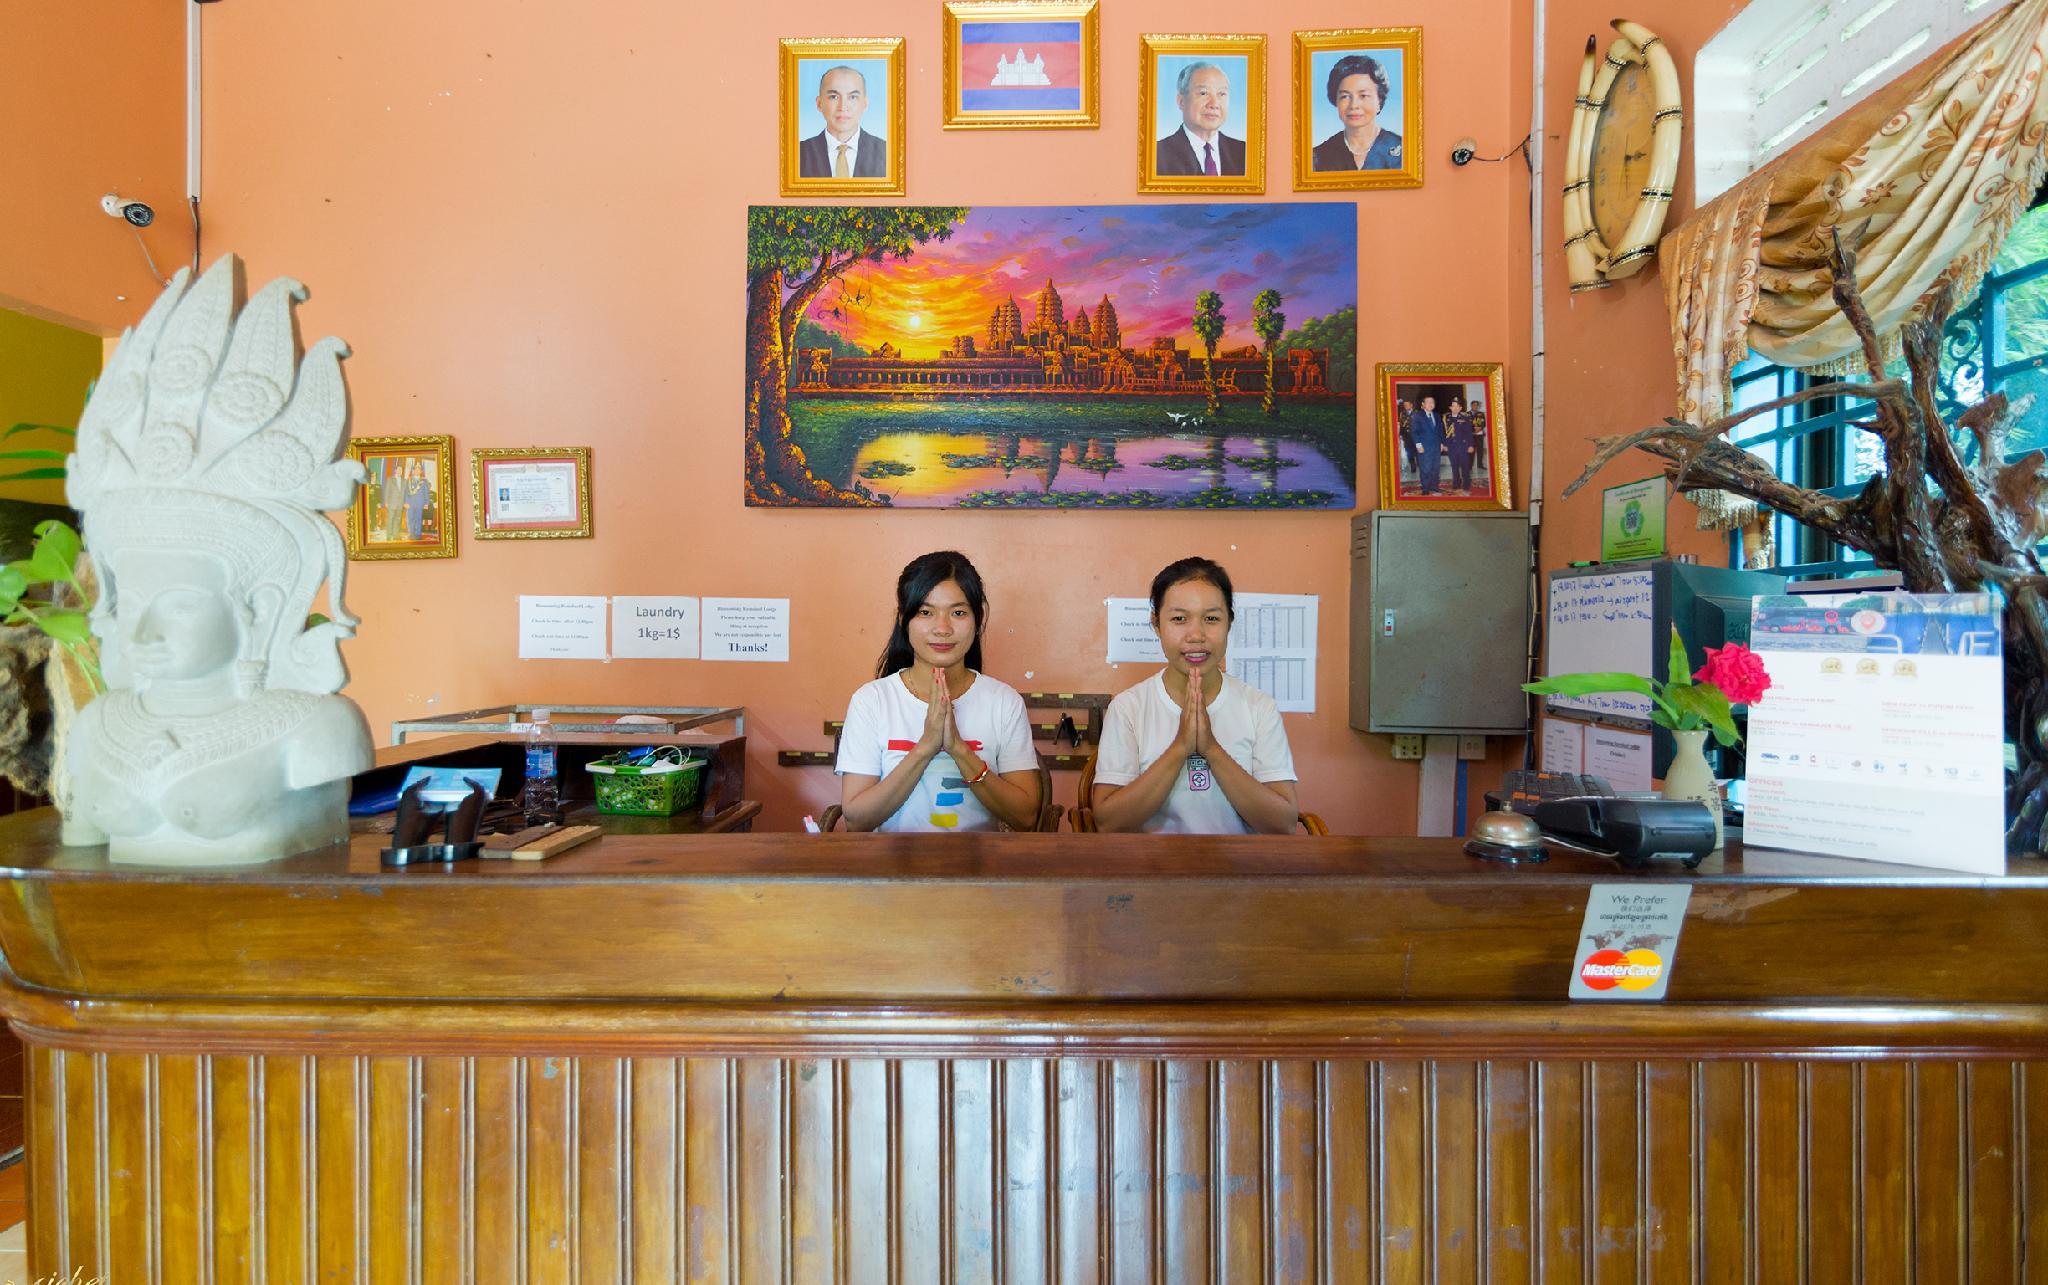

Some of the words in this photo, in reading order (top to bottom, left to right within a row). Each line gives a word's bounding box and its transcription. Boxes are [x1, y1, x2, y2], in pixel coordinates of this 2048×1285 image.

[635, 605, 685, 619] Laundry
[638, 627, 680, 641] 1kg=1$
[728, 642, 768, 653] Thanks!
[1611, 895, 1630, 904] We
[1632, 895, 1668, 904] Prefer
[1582, 964, 1660, 976] MasterCard
